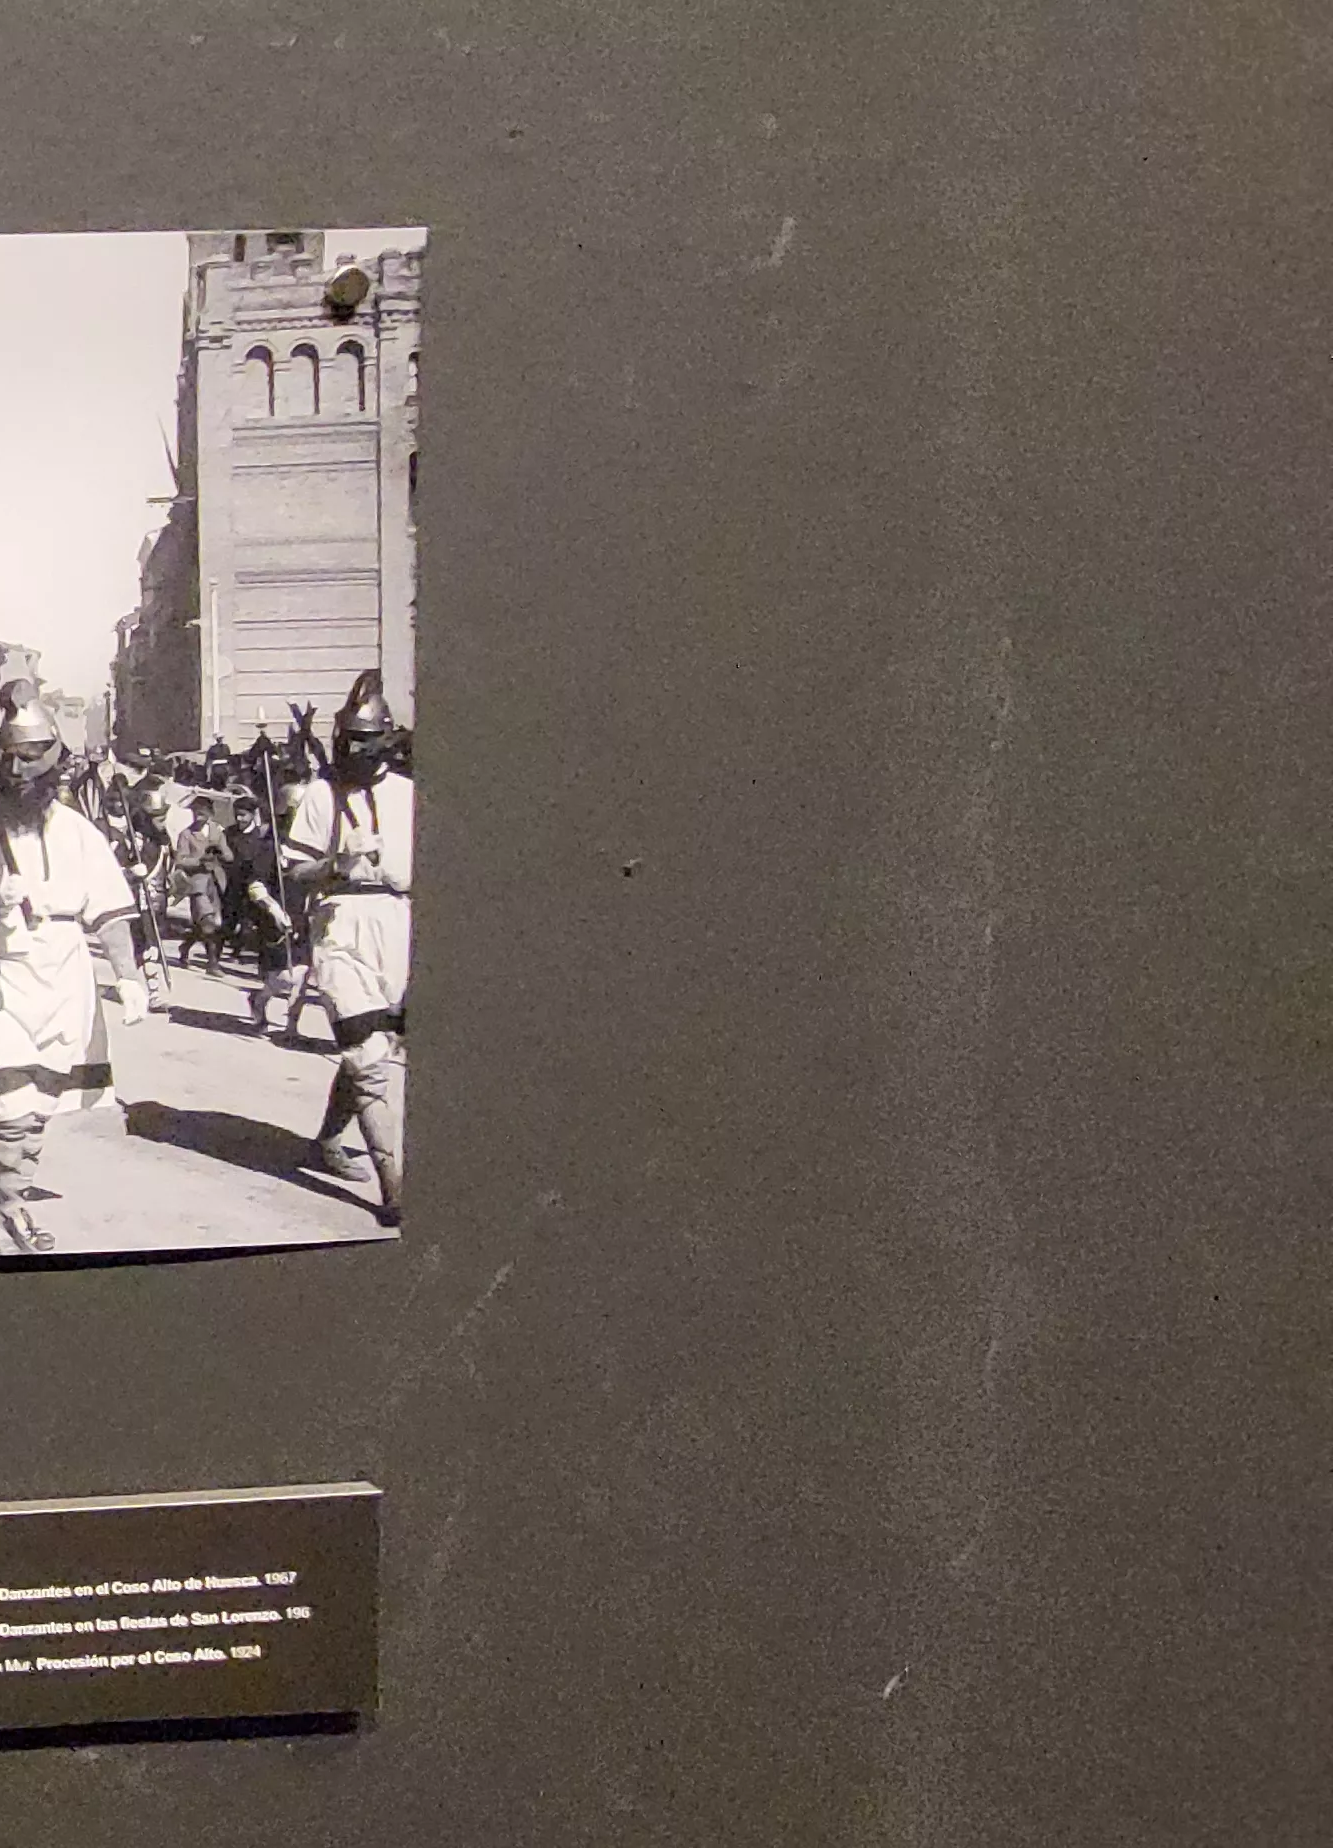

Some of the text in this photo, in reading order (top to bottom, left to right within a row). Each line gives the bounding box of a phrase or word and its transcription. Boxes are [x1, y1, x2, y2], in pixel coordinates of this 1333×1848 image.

[74, 1585, 94, 1597] en
[96, 1582, 110, 1596] el
[112, 1580, 150, 1594] Coso
[152, 1578, 182, 1593] Alto
[184, 1577, 203, 1590] de
[205, 1576, 262, 1590] Huesca.
[264, 1571, 298, 1586] 1967
[75, 1620, 94, 1633] en
[96, 1618, 118, 1631] las
[120, 1616, 168, 1630] fiestas
[169, 1613, 189, 1628] de
[190, 1611, 219, 1625] San
[221, 1610, 283, 1625] Lorenzo.
[36, 1654, 109, 1671] Procesión
[111, 1654, 136, 1670] por
[137, 1651, 152, 1665] el
[153, 1649, 192, 1665] Coso
[193, 1647, 229, 1662] Alto.
